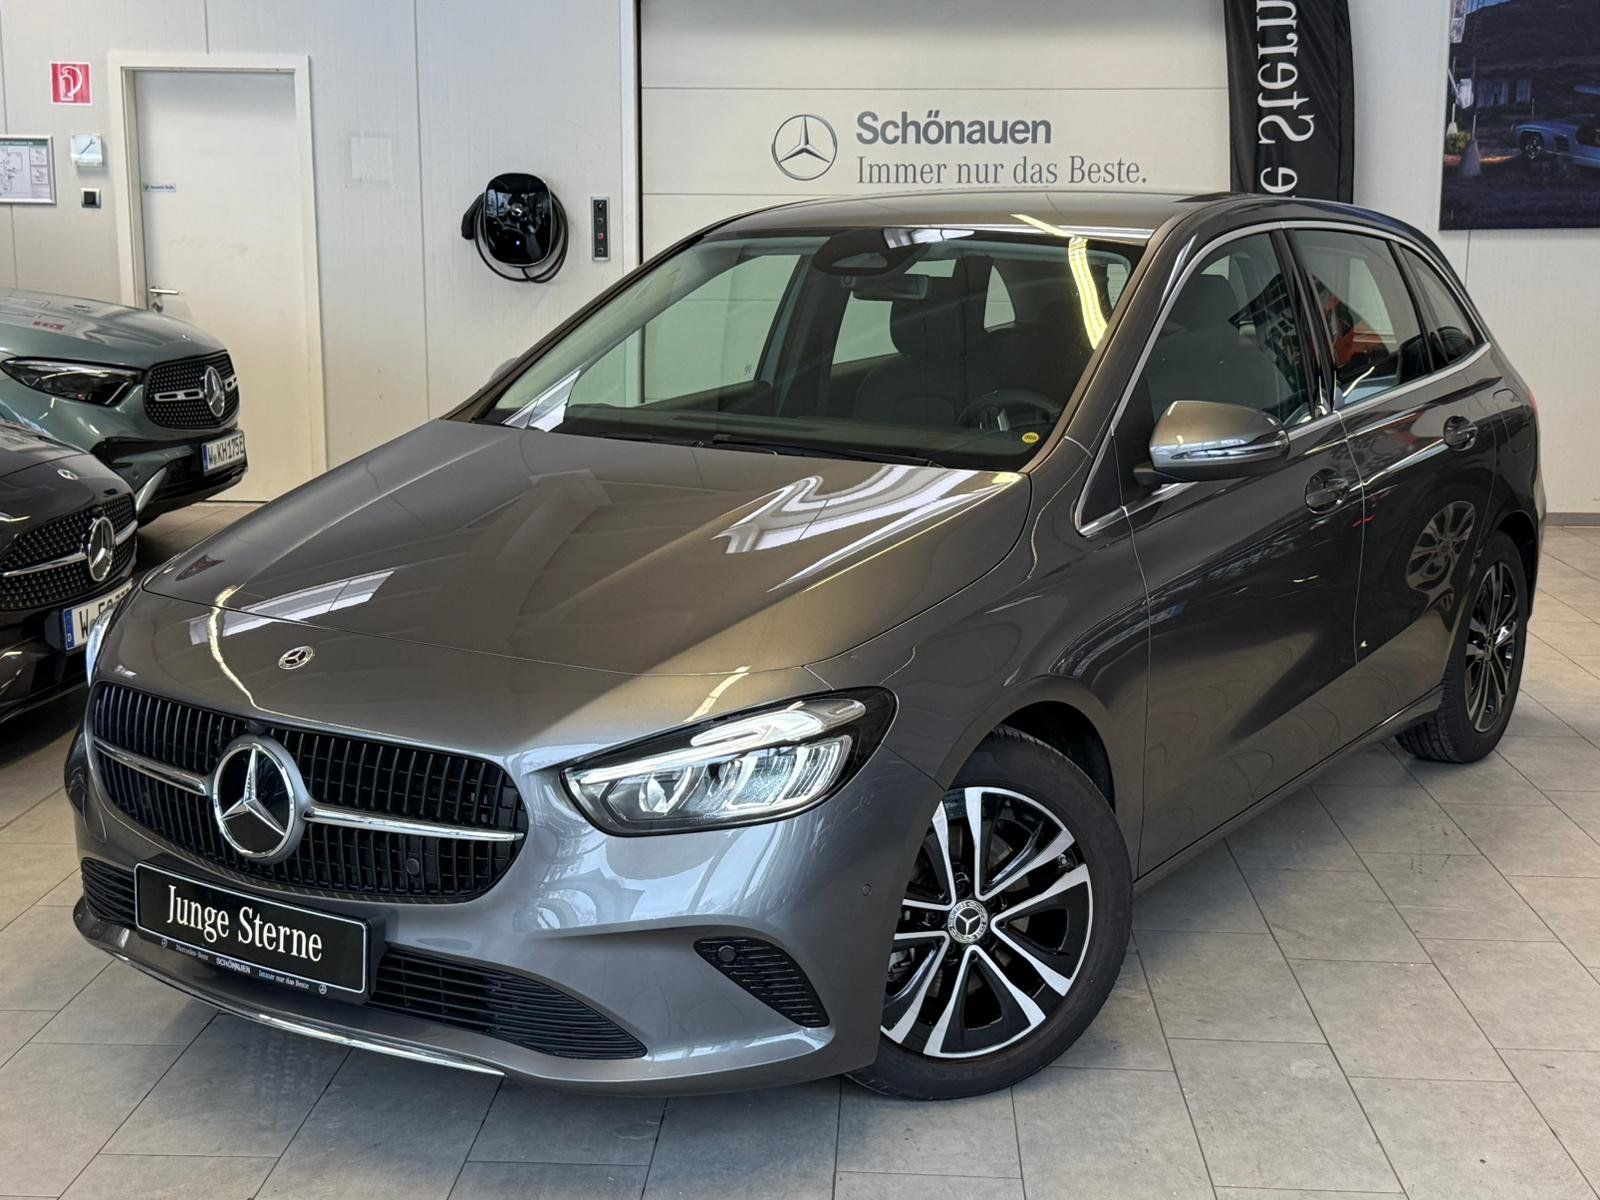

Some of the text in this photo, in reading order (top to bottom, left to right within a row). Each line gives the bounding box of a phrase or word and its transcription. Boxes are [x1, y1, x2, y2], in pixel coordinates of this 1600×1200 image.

[856, 109, 1052, 145] Schönauen
[856, 155, 1147, 185] Immer nur das Beste.
[79, 607, 89, 639] W
[166, 884, 323, 963] Junge Sterne
